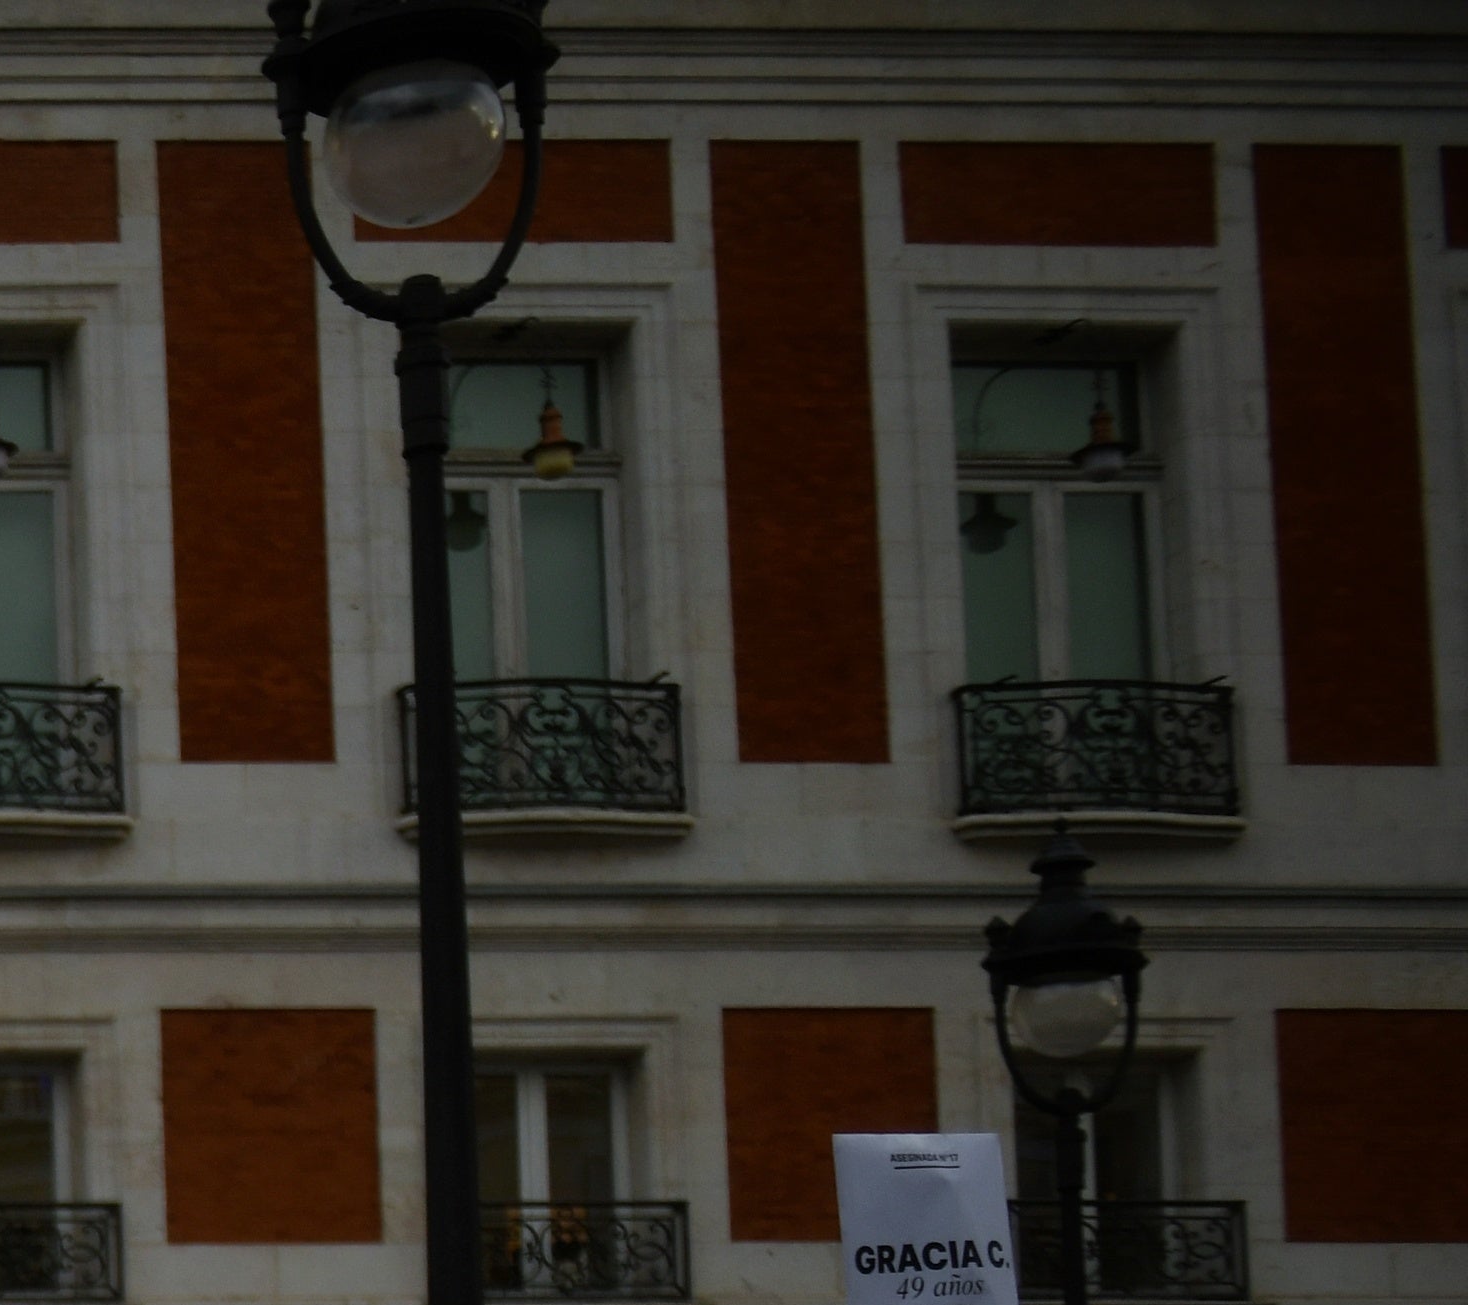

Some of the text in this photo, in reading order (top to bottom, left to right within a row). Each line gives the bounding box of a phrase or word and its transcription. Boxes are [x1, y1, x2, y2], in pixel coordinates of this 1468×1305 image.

[854, 1239, 1010, 1275] GRACIA C.
[896, 1274, 985, 1300] 49 años
